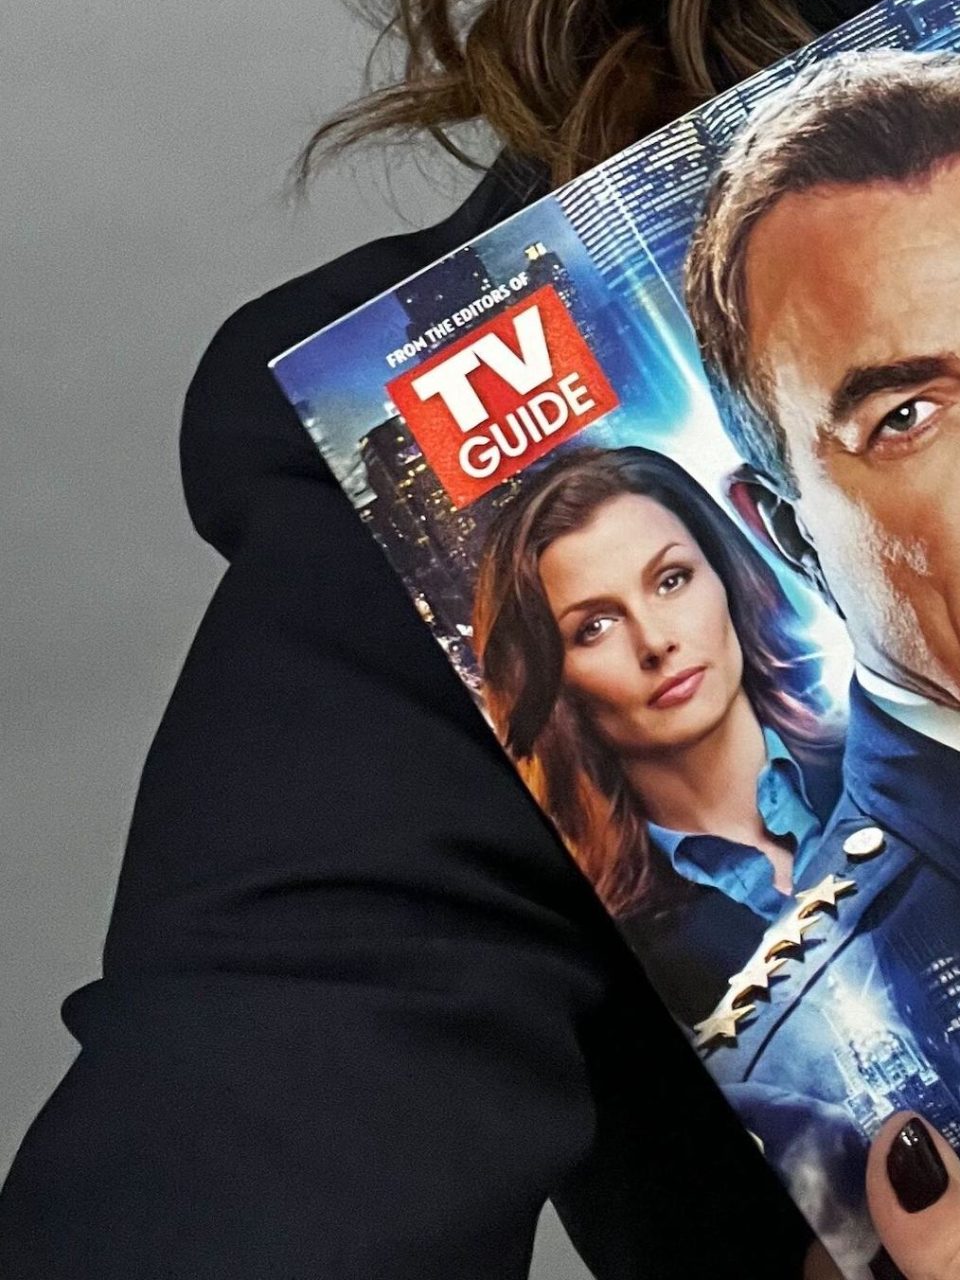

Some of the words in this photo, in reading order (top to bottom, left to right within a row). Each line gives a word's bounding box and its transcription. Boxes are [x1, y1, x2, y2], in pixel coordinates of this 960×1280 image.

[385, 336, 427, 368] FROM
[425, 319, 455, 343] THE
[451, 284, 511, 327] EDITORS
[509, 271, 529, 291] OF
[411, 304, 554, 433] TV
[459, 371, 595, 478] GUIDE
